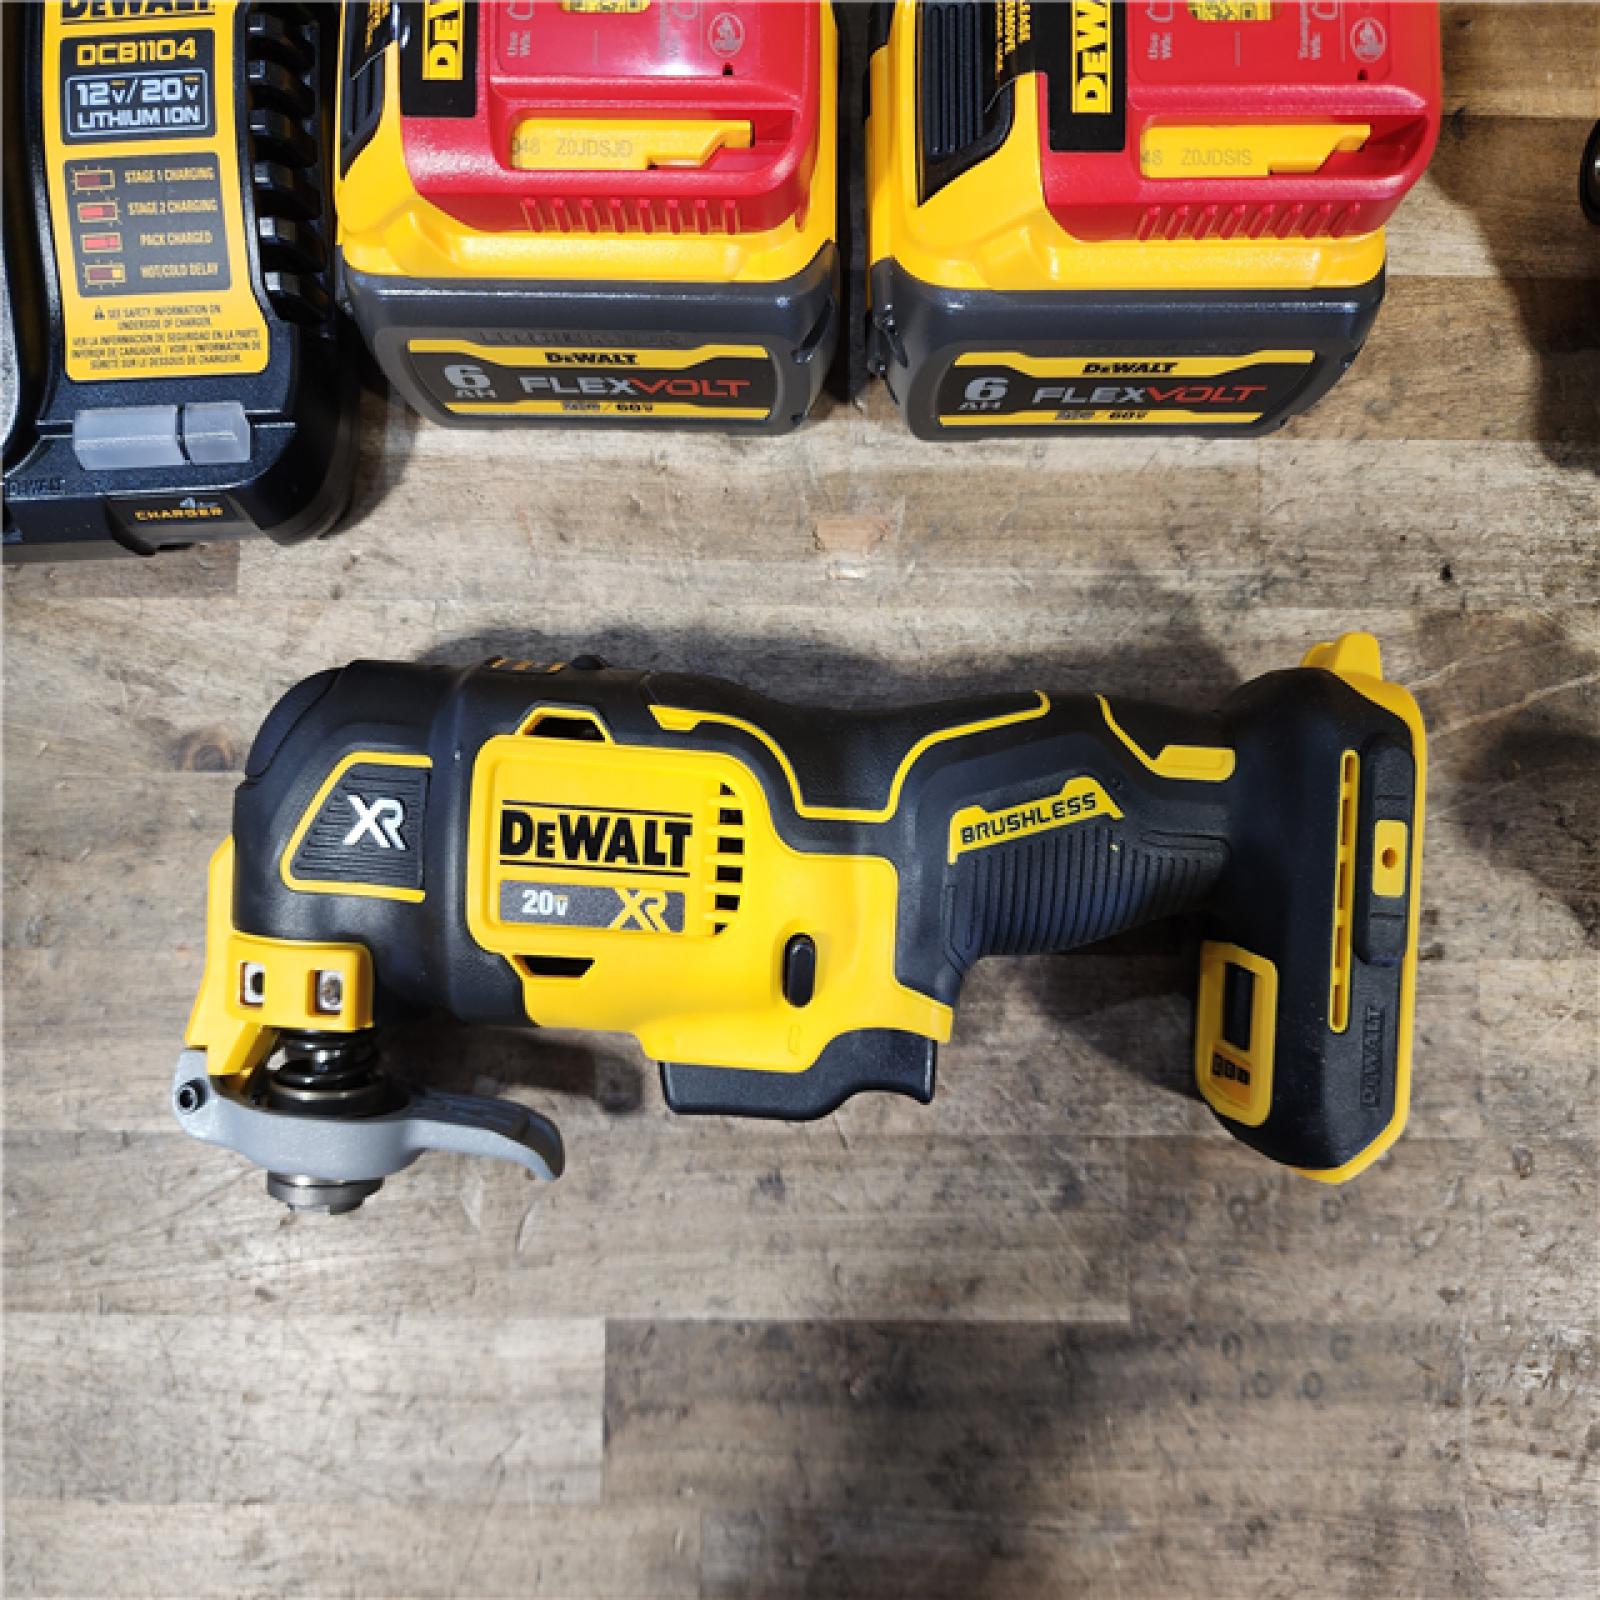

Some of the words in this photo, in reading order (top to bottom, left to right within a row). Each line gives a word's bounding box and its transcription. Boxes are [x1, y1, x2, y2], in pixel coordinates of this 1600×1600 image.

[77, 109, 161, 129] LITHIUM
[164, 105, 199, 125] ION
[124, 169, 156, 184] STAGE
[164, 166, 215, 182] CHARGING
[127, 201, 158, 216] STAGE
[167, 197, 218, 213] CHARGING
[167, 229, 213, 245] CHARGED
[154, 304, 208, 316] INFORMATION
[445, 364, 491, 389] 6
[519, 375, 751, 398] FLEXVOLT
[964, 377, 1009, 401] 6
[1032, 385, 1268, 404] FLEXVOLT
[343, 794, 406, 851] XR
[960, 792, 1096, 845] BRUSHLESS
[607, 887, 671, 933] XR
